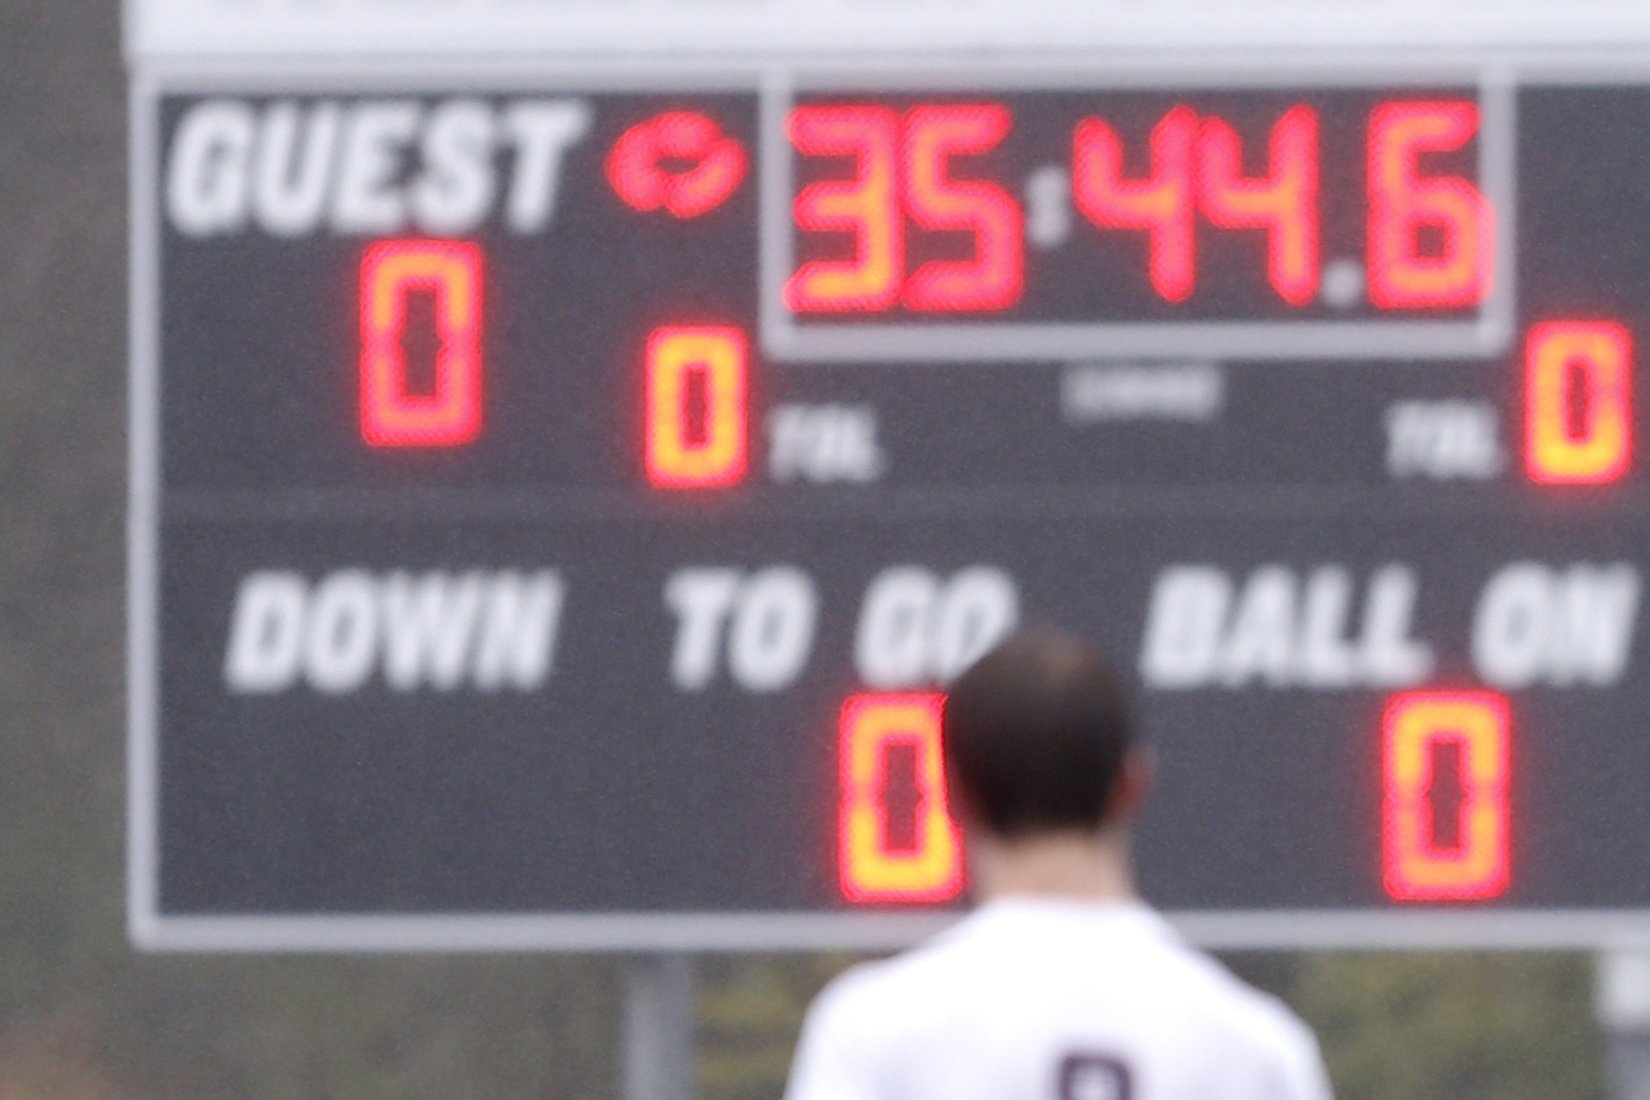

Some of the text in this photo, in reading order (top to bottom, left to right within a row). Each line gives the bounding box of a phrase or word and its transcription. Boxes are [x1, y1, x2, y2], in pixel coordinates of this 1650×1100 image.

[166, 98, 594, 237] GUEST
[359, 238, 484, 447] 0
[644, 323, 749, 489] 0
[1523, 320, 1634, 486] 0
[223, 566, 566, 694] DOWN
[663, 563, 1020, 693] TO GO
[1138, 560, 1642, 691] BALL ON
[839, 689, 966, 904] 0
[1380, 688, 1512, 902] 0
